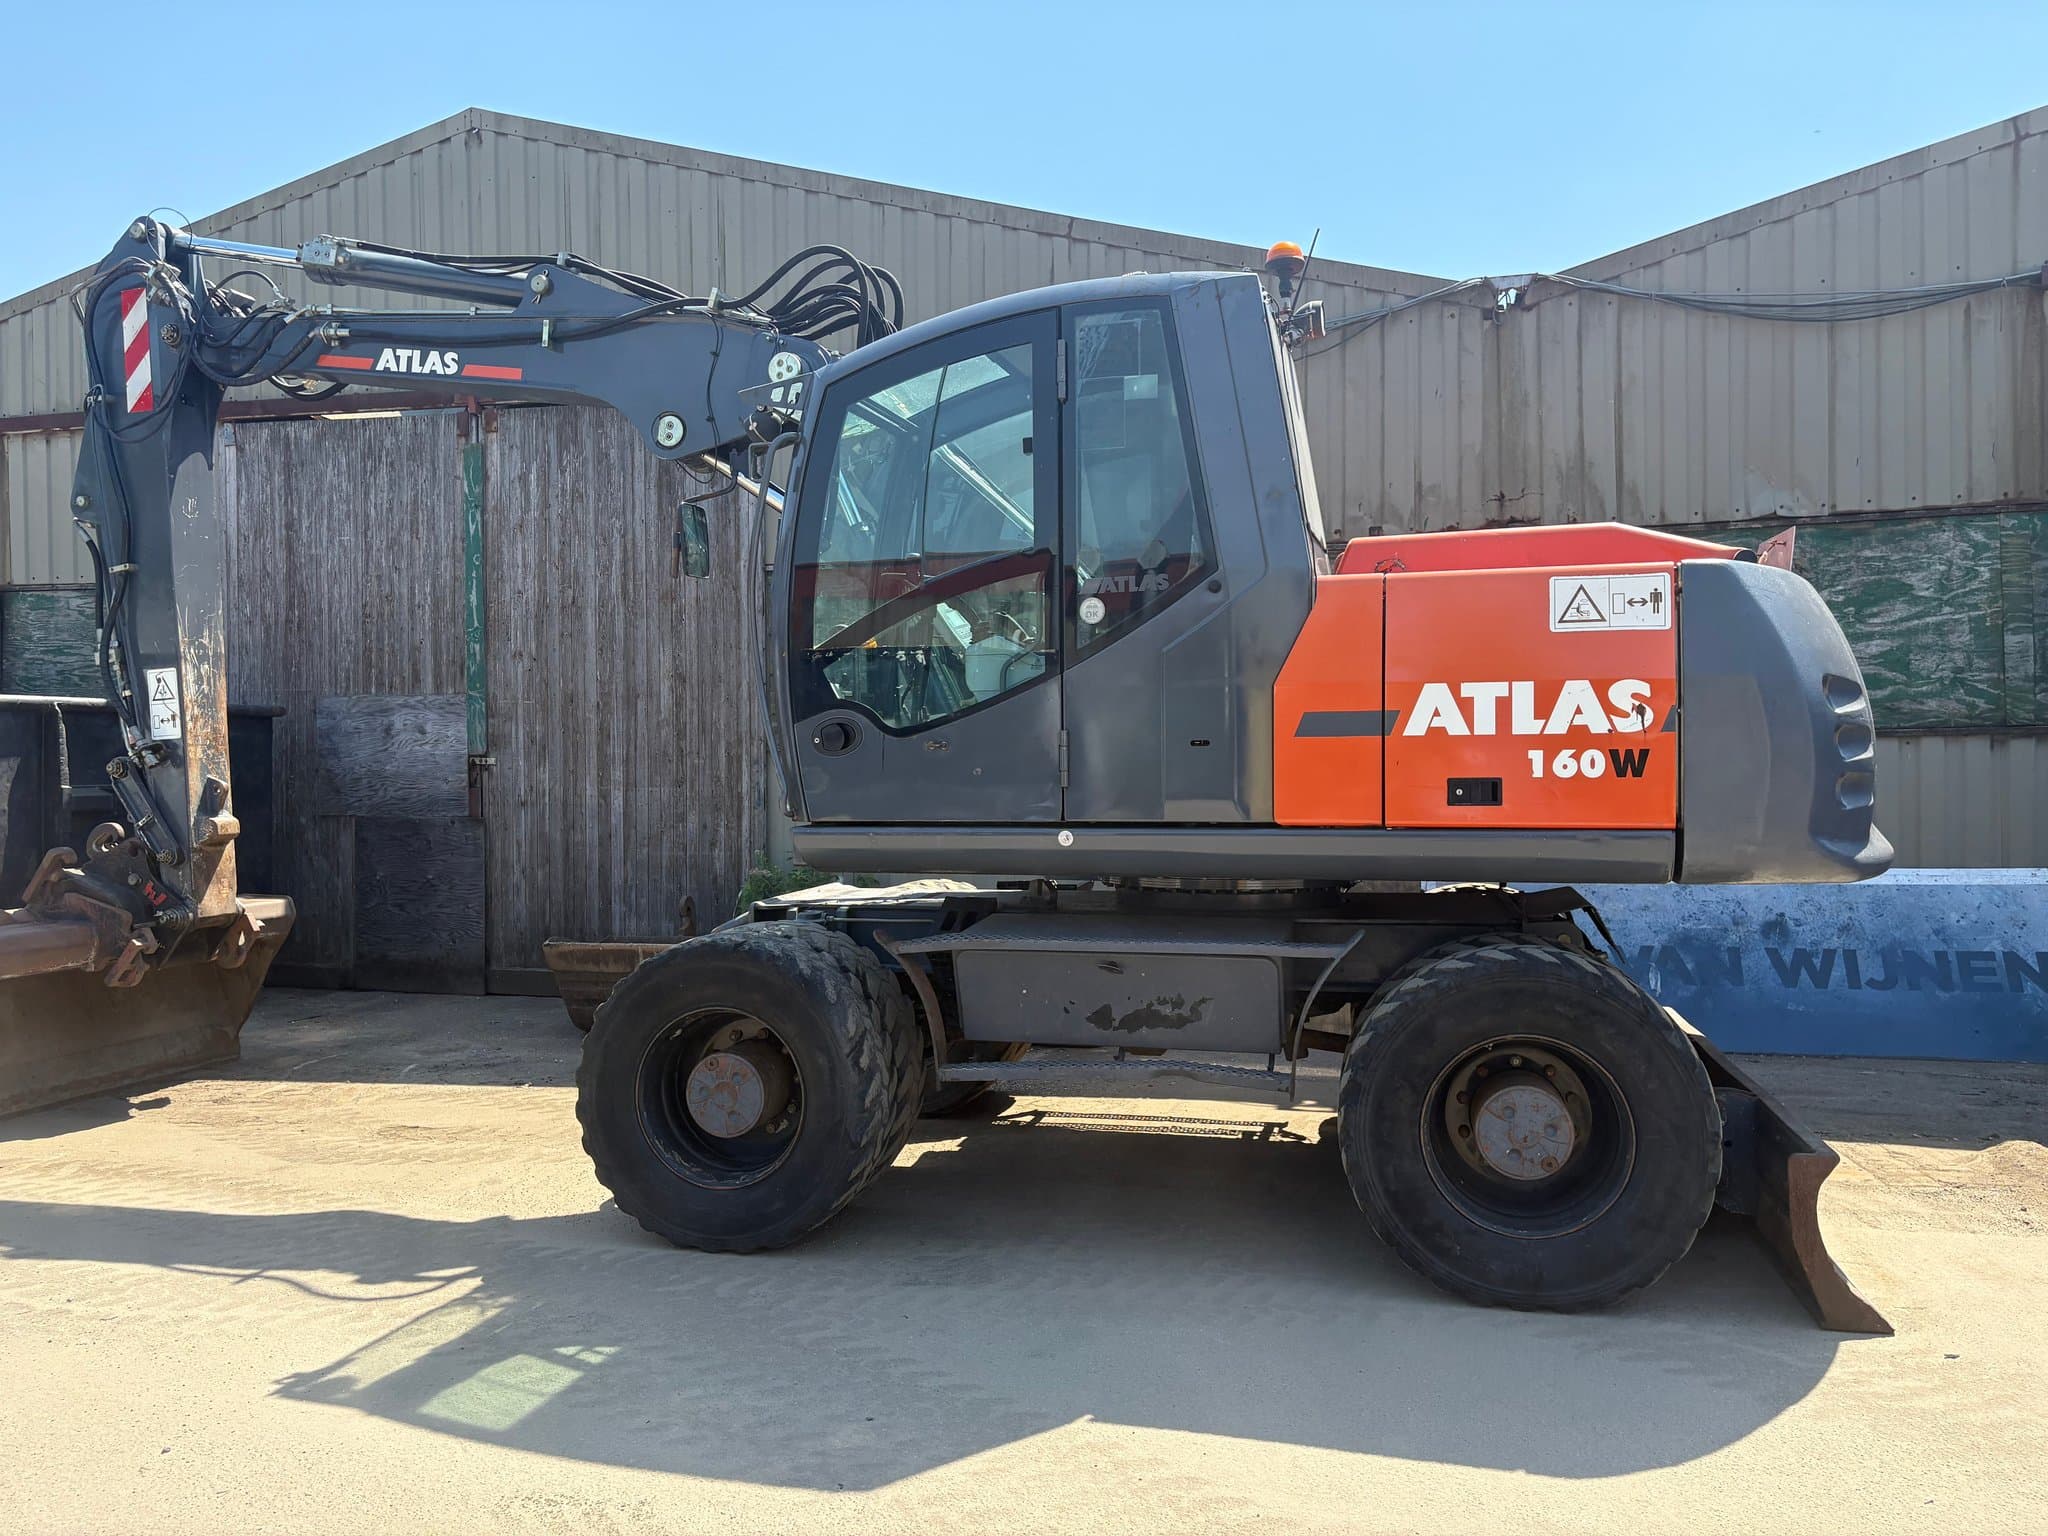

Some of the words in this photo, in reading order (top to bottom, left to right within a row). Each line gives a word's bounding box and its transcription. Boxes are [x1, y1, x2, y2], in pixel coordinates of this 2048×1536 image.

[375, 348, 458, 375] ATLAS
[1098, 573, 1169, 593] ATLAS
[1402, 679, 1654, 736] ATLAS
[1527, 749, 1650, 779] 160W
[1608, 945, 1744, 988] VAN
[1764, 947, 2048, 994] WIJNEN
